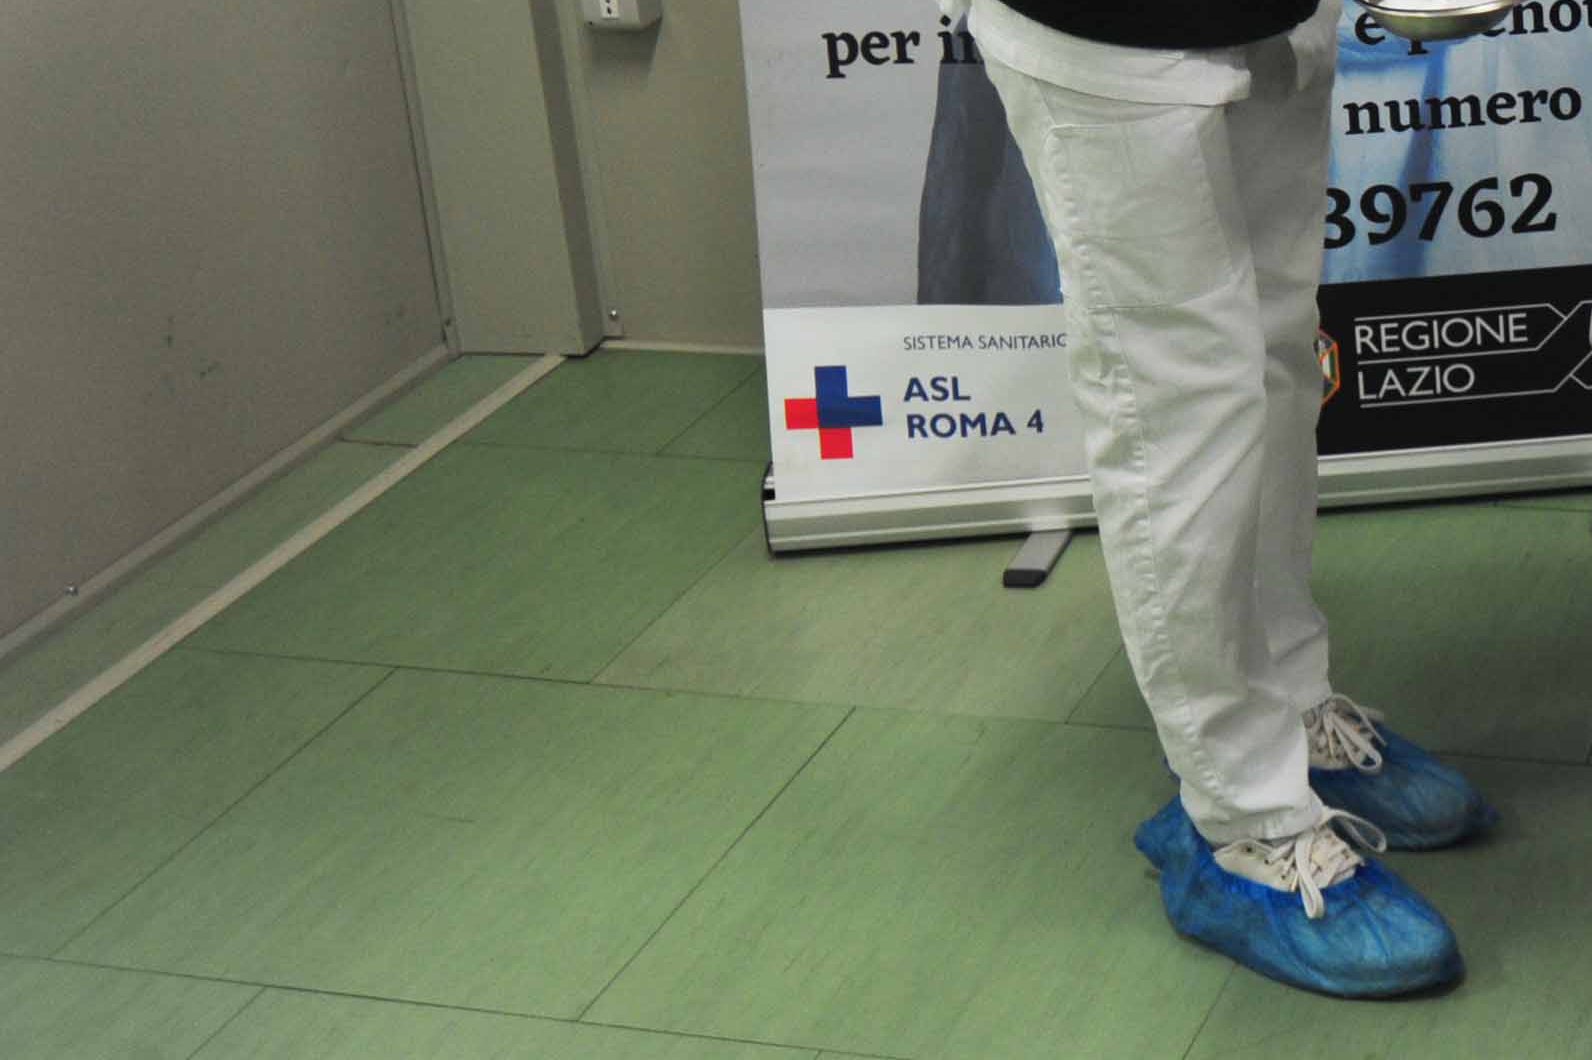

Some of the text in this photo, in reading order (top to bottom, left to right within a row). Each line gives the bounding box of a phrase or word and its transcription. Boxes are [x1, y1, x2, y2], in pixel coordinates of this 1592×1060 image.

[821, 31, 921, 79] per
[1343, 86, 1582, 135] numero
[1323, 173, 1558, 250] 39762
[903, 335, 974, 351] SISTEMA
[1354, 312, 1529, 355] REGIONE
[903, 376, 972, 402] ASL
[1358, 363, 1476, 400] LAZIO
[906, 408, 1044, 439] ROMA 4
